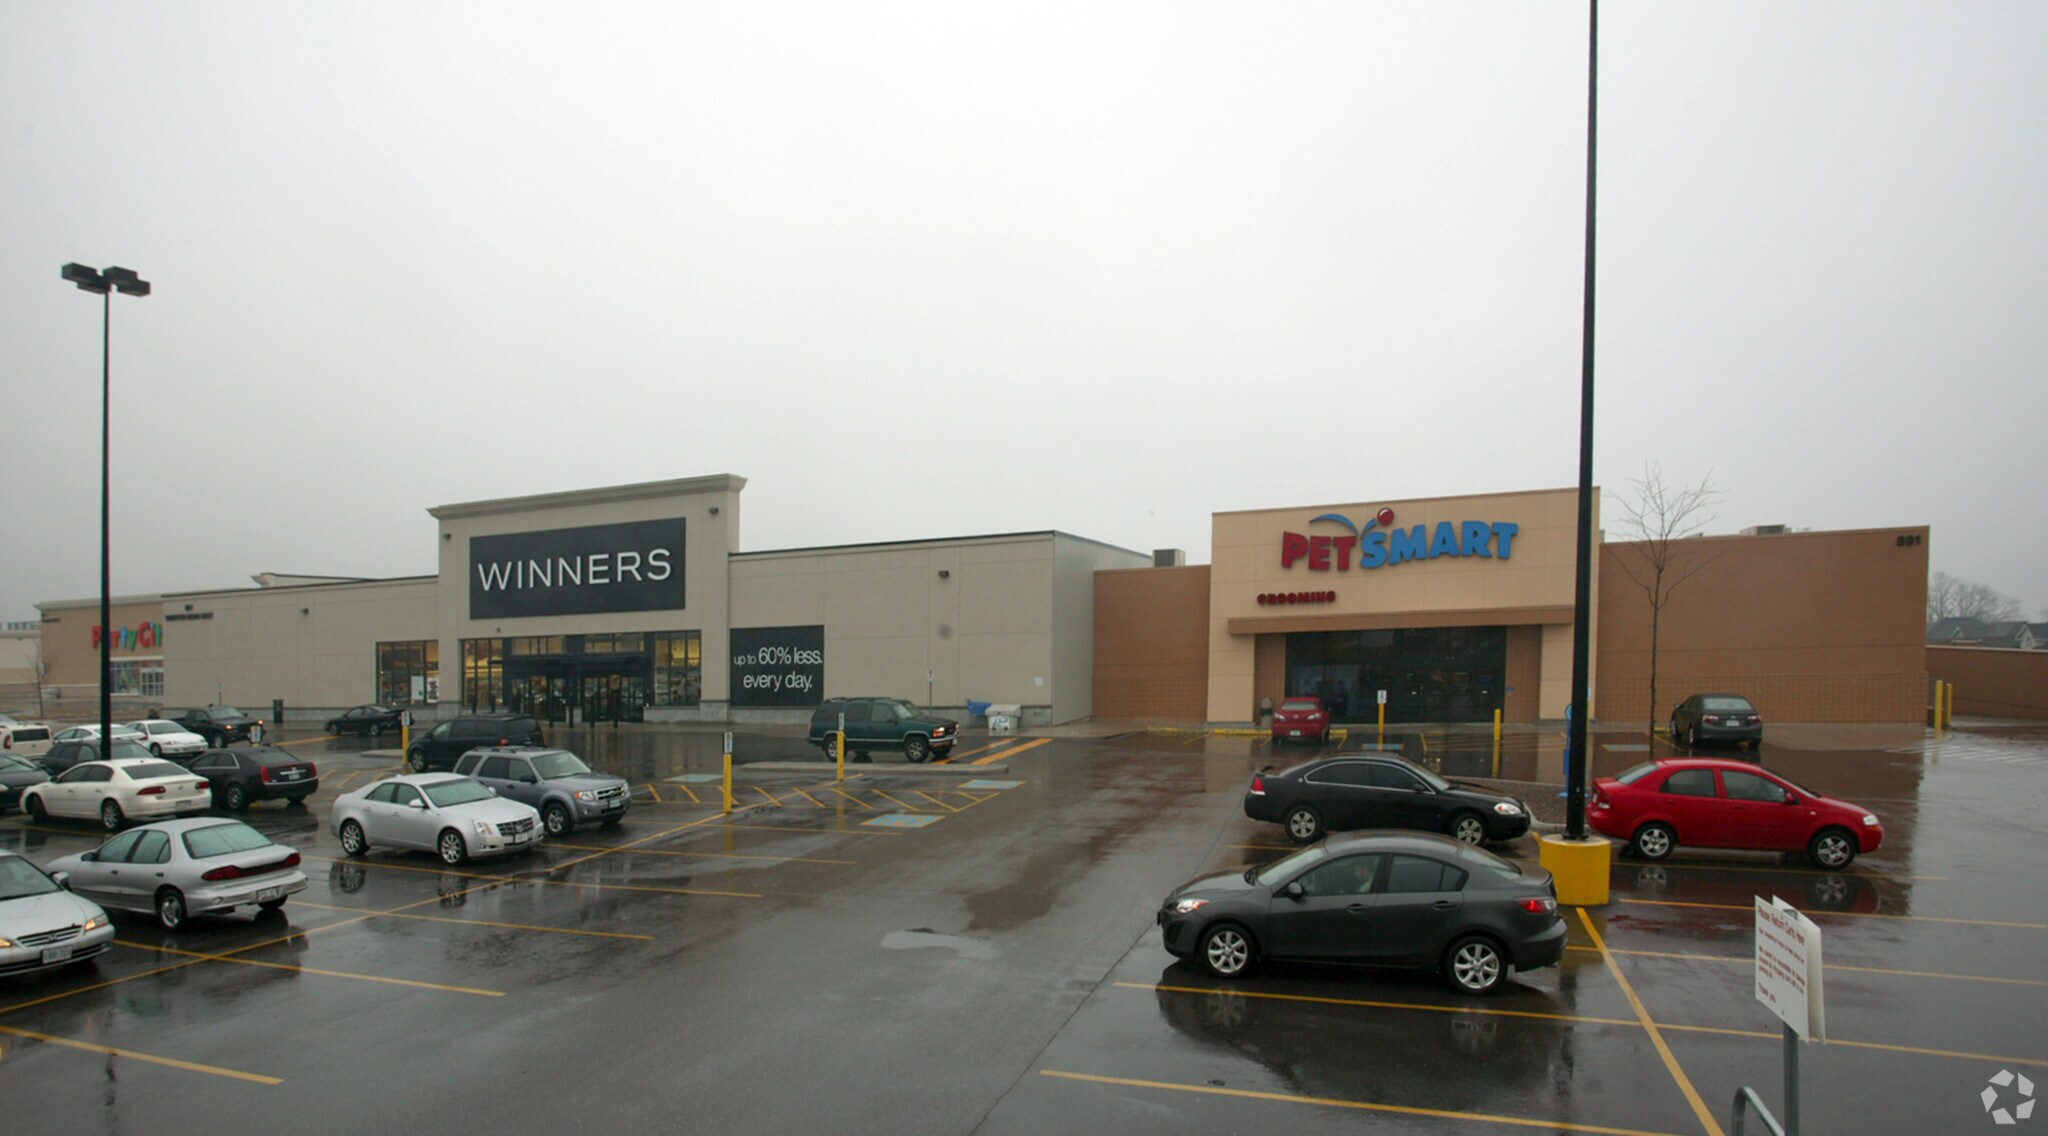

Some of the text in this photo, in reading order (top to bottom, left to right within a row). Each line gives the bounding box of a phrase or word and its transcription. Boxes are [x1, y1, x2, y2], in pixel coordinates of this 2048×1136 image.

[477, 548, 671, 592] WINNERS
[1257, 590, 1337, 605] GROOMING
[92, 624, 138, 651] Prty
[733, 646, 823, 667] up to 60% less.
[743, 670, 813, 693] every day.
